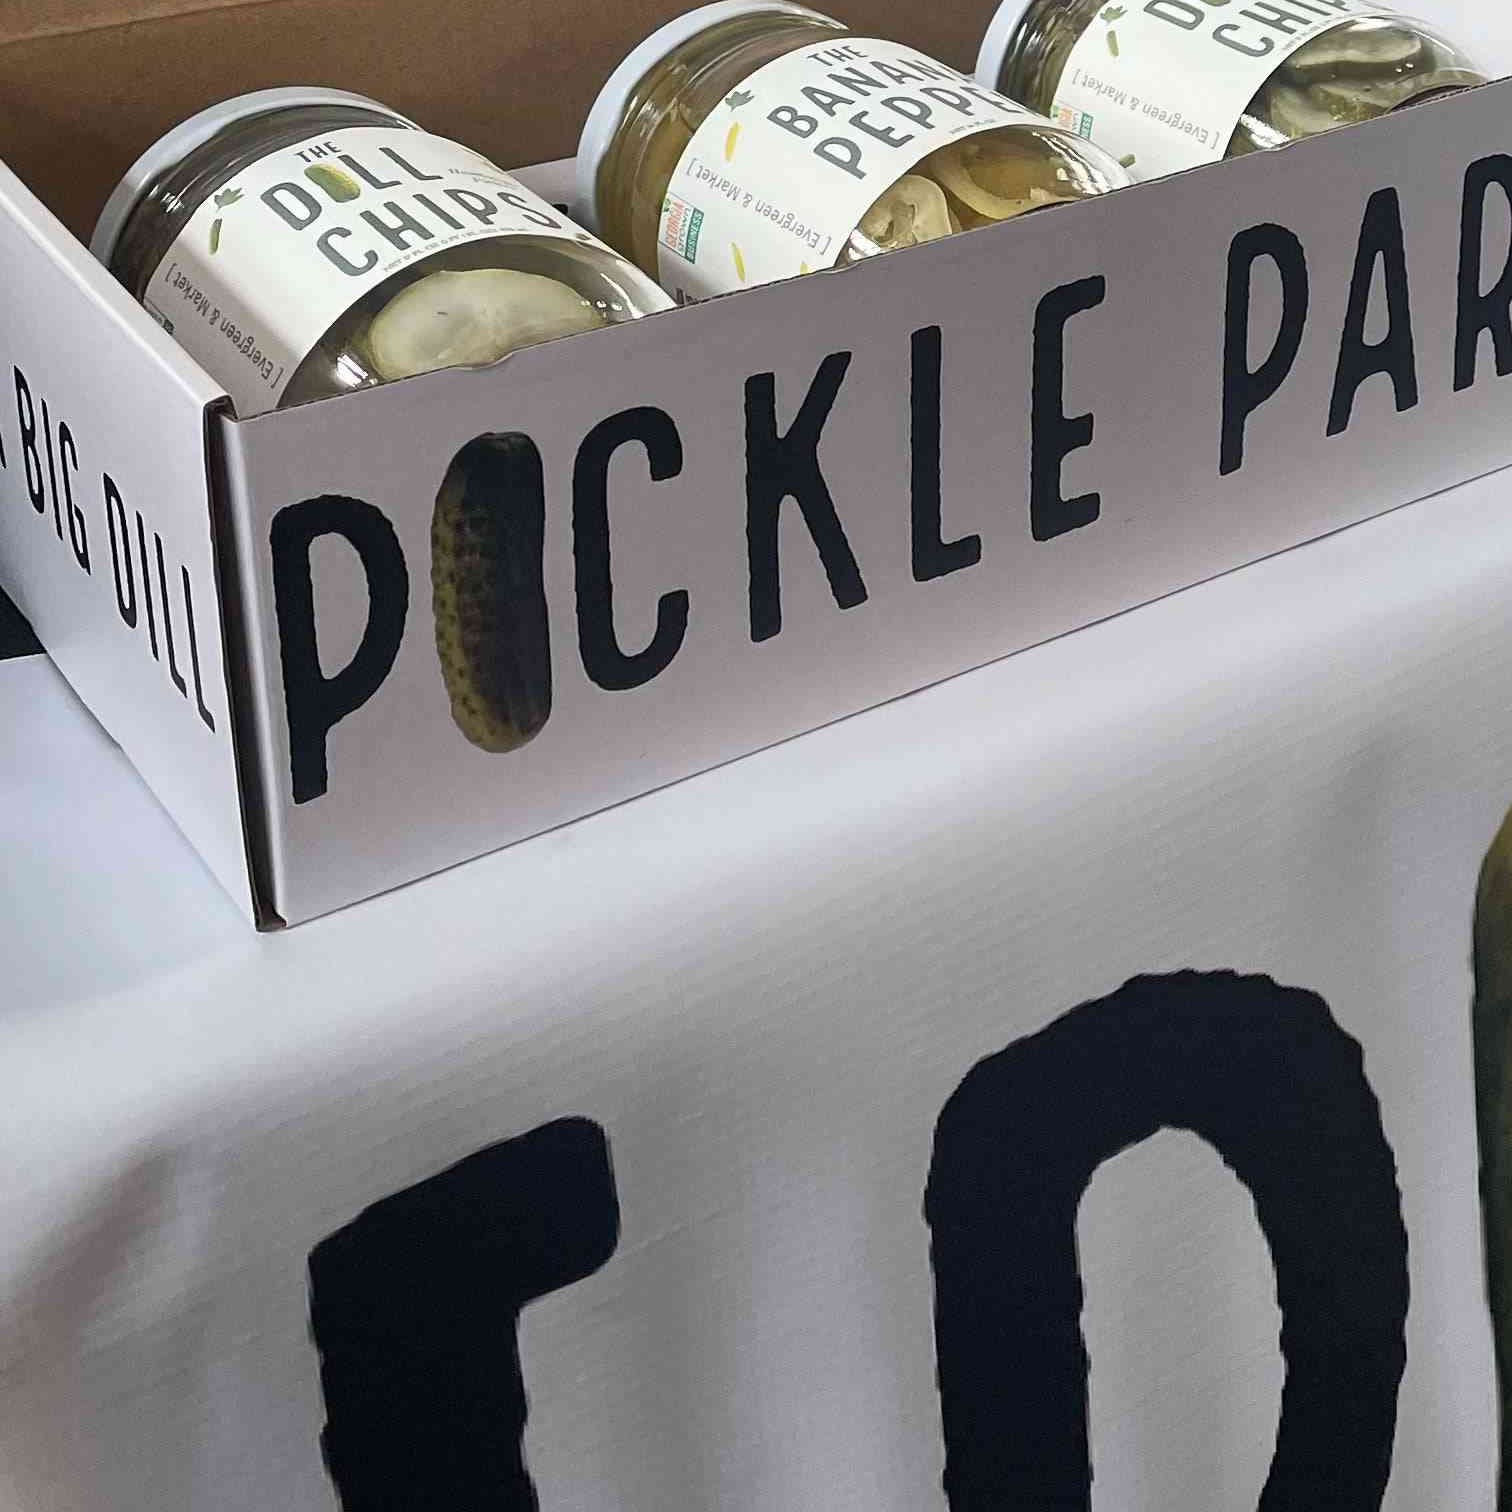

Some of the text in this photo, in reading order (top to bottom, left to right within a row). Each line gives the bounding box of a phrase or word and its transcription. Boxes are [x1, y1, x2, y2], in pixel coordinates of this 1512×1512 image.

[806, 44, 868, 68] THE
[1081, 77, 1128, 107] Market
[1142, 102, 1209, 146] Evergreen
[296, 141, 340, 164] THE
[260, 146, 444, 231] DILL
[695, 159, 742, 202] Market
[316, 189, 563, 278] CHIPS
[755, 197, 821, 251] Evergreen
[174, 268, 212, 322] Market
[219, 320, 276, 381] Evergreen
[14, 364, 215, 734] BIG DILL
[268, 274, 1106, 806] PICKLE
